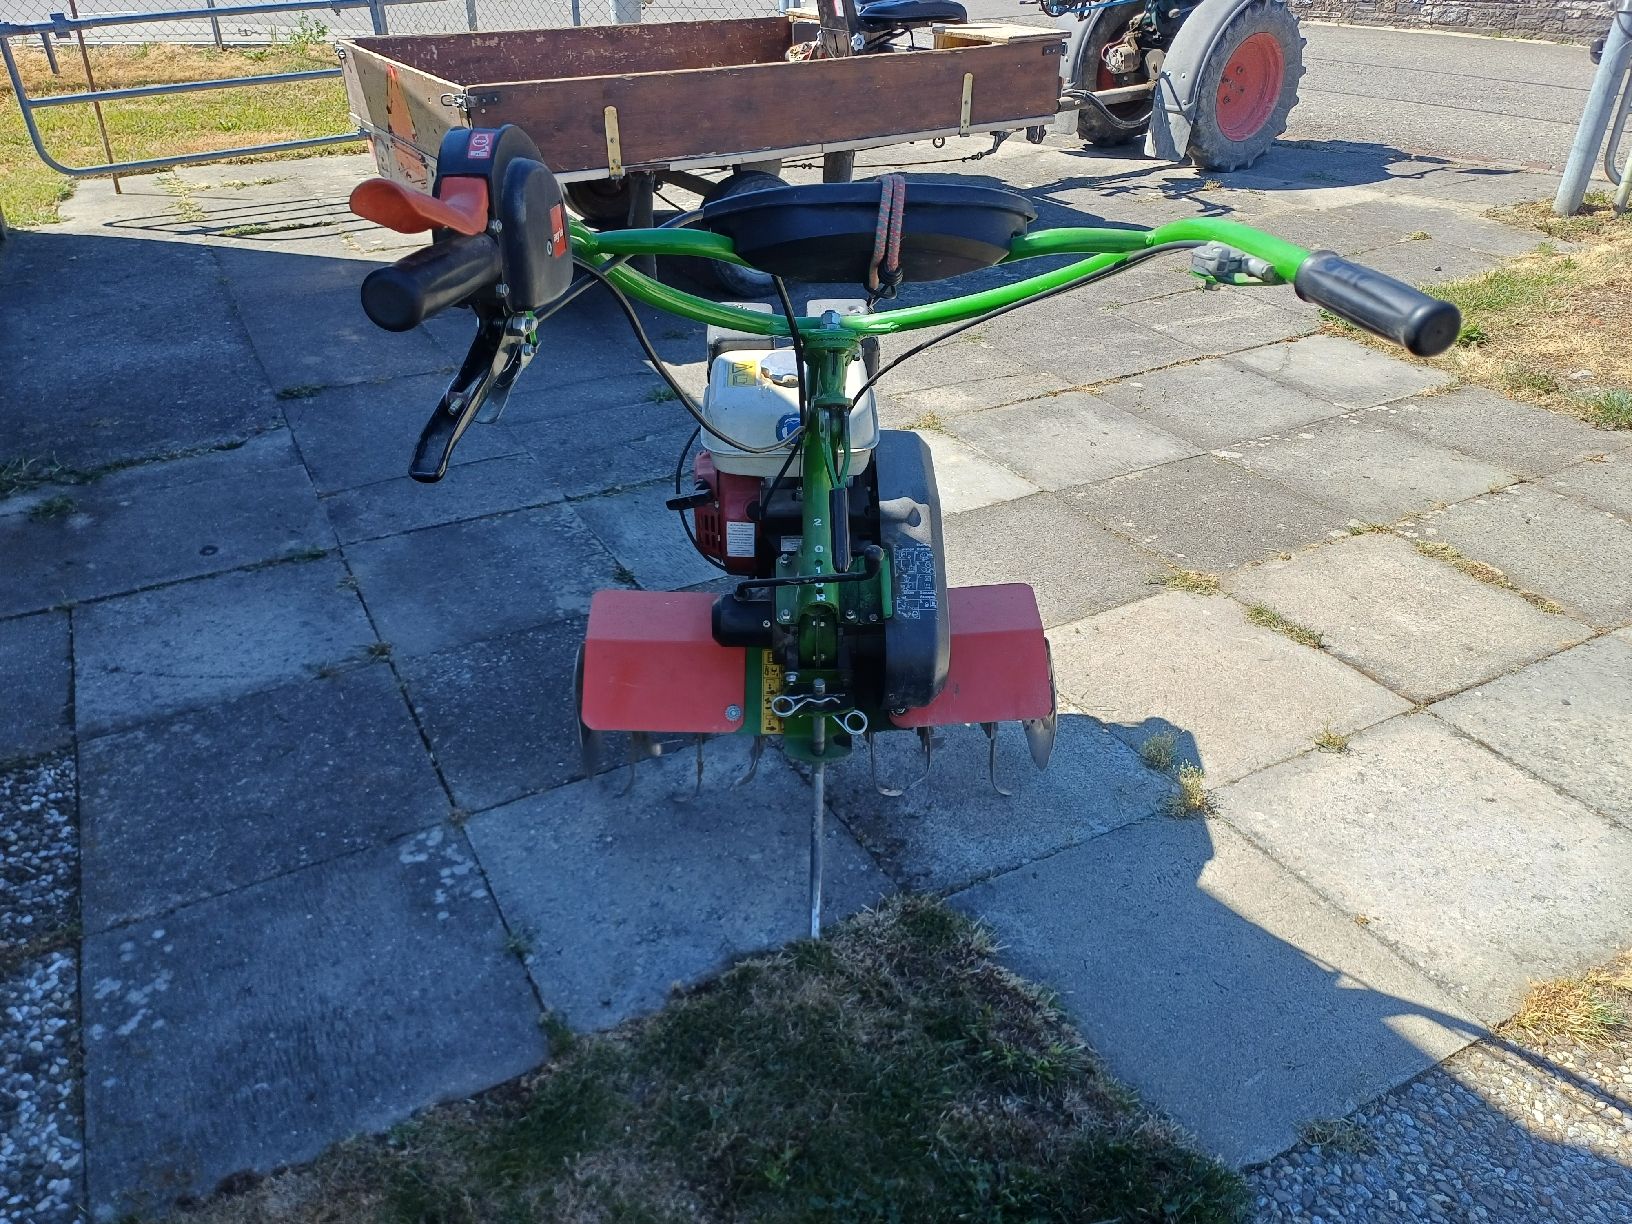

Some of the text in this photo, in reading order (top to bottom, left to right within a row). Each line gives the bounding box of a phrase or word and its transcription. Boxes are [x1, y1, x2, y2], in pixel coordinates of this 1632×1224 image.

[813, 518, 822, 526] 2
[815, 566, 821, 574] 1
[815, 593, 826, 601] R
